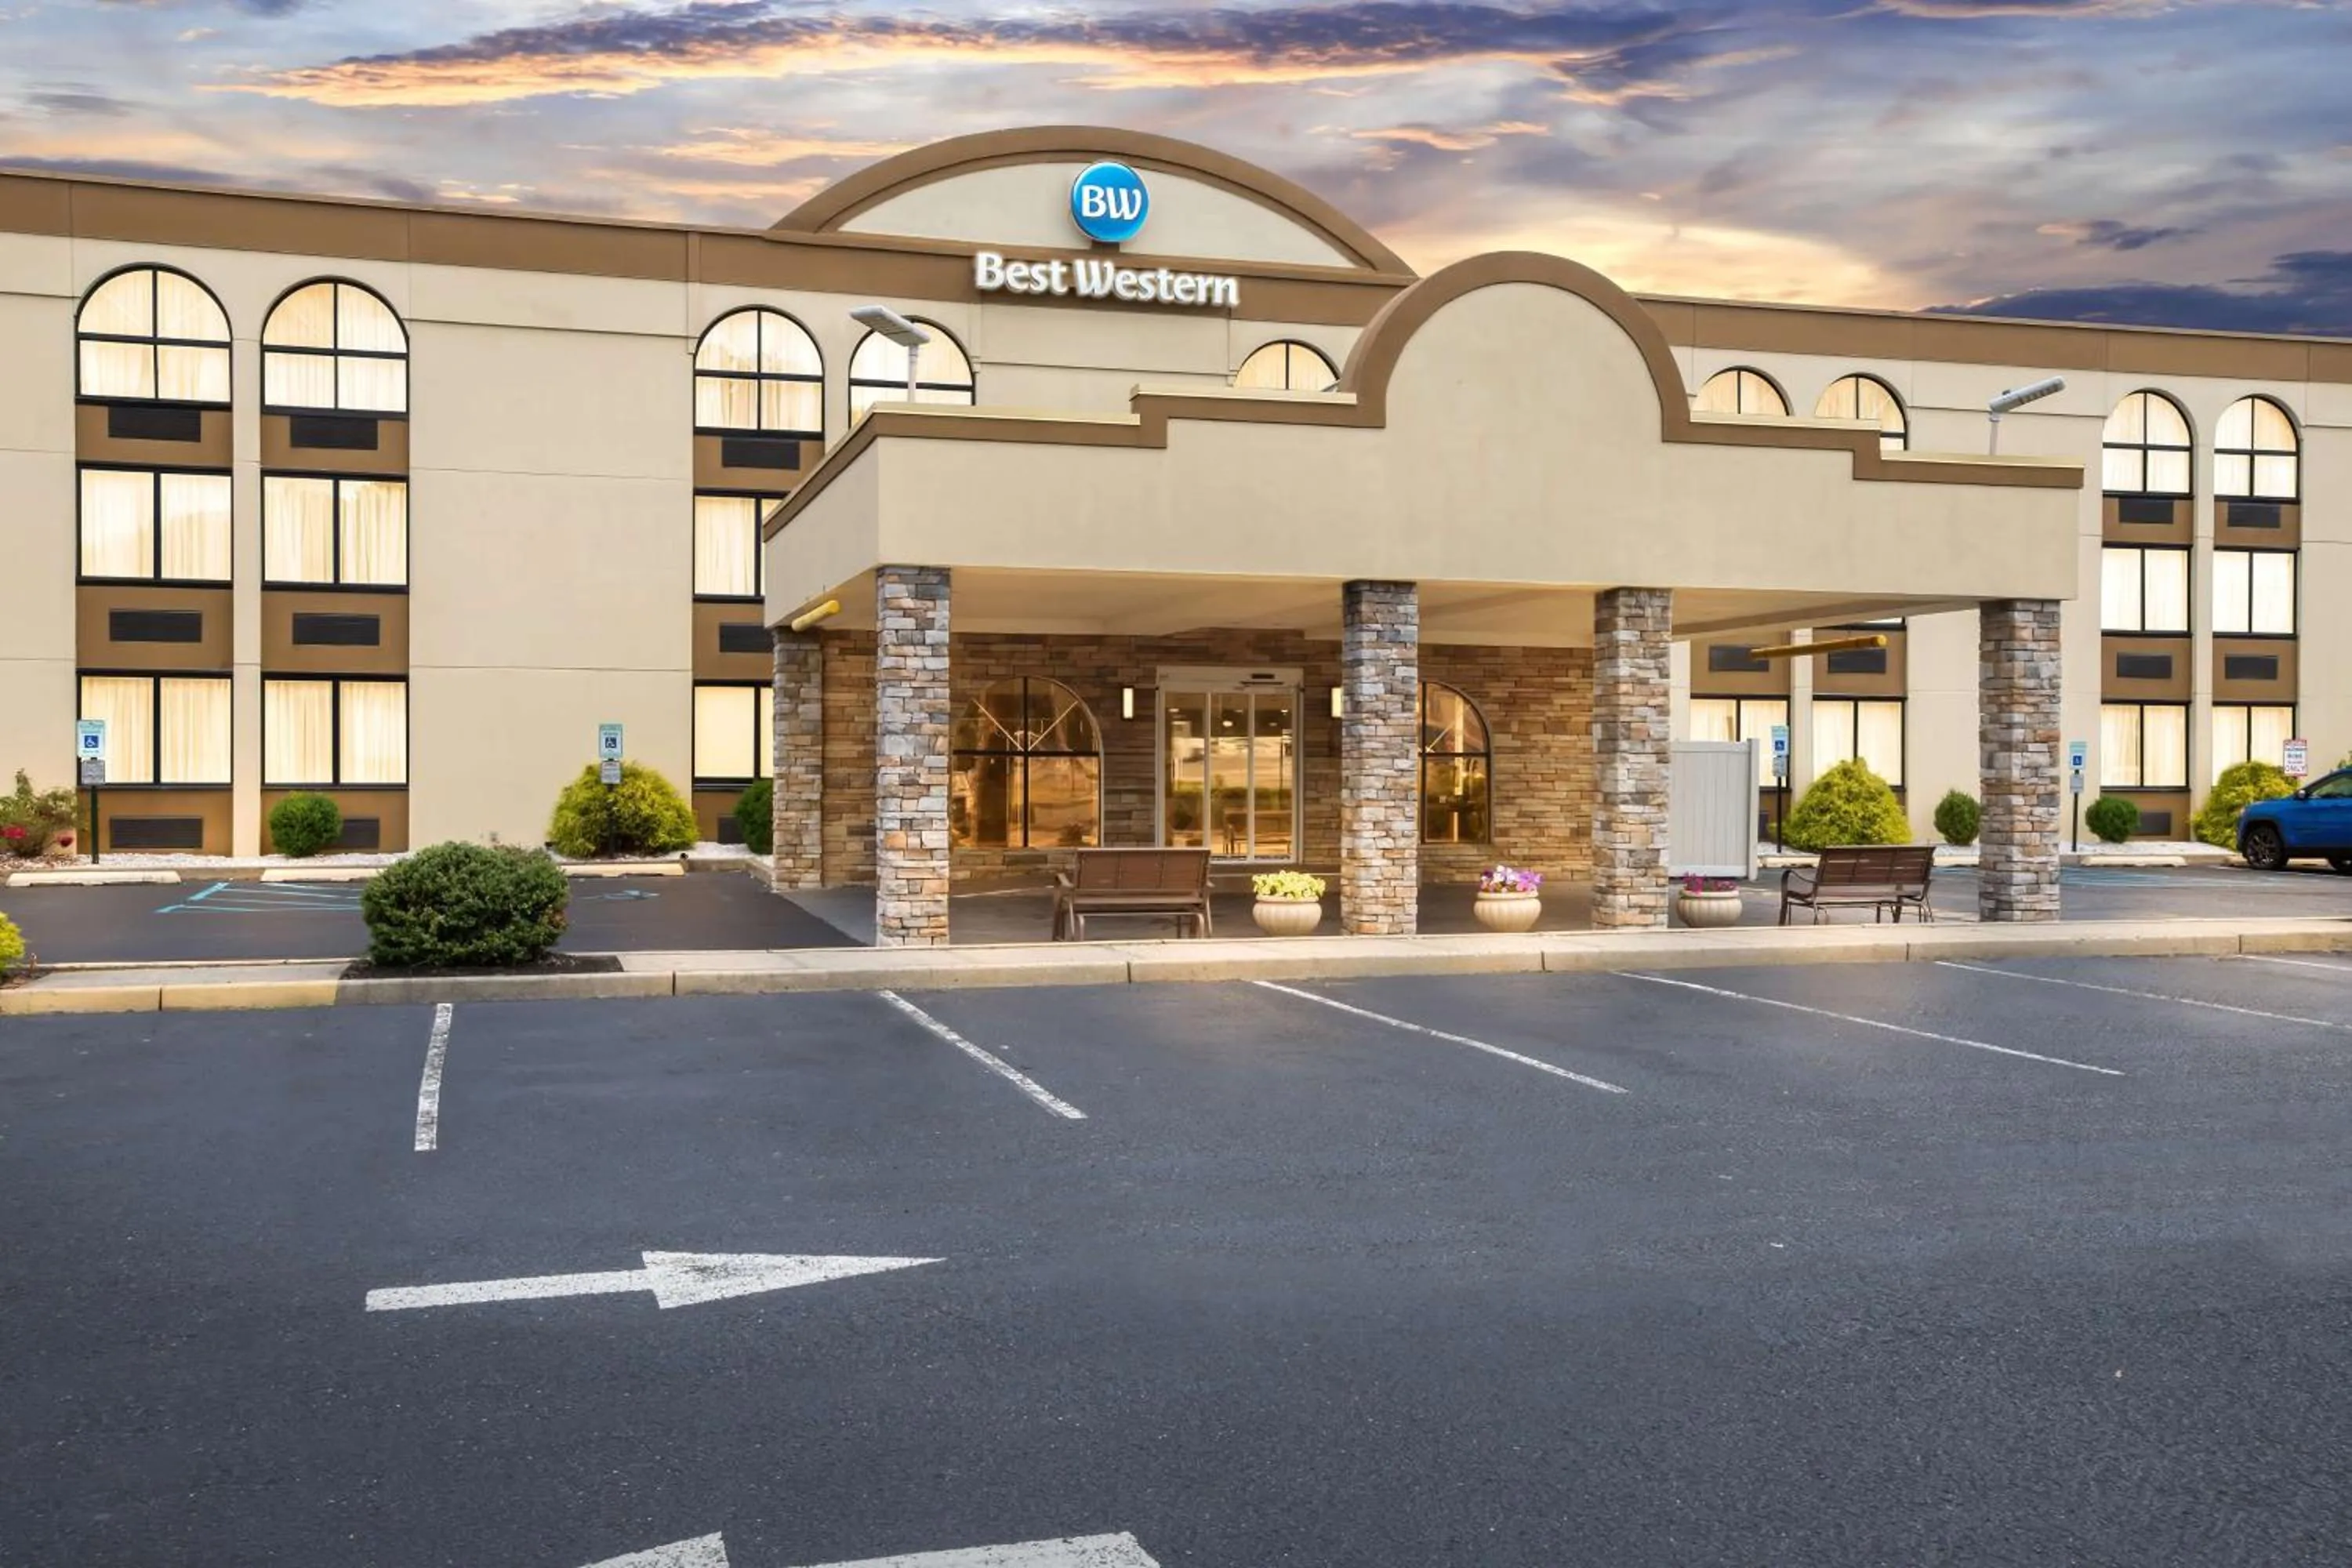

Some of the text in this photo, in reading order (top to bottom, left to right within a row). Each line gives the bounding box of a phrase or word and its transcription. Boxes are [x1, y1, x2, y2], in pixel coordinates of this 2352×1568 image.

[1080, 183, 1142, 221] BW
[975, 251, 1240, 307] Best Western
